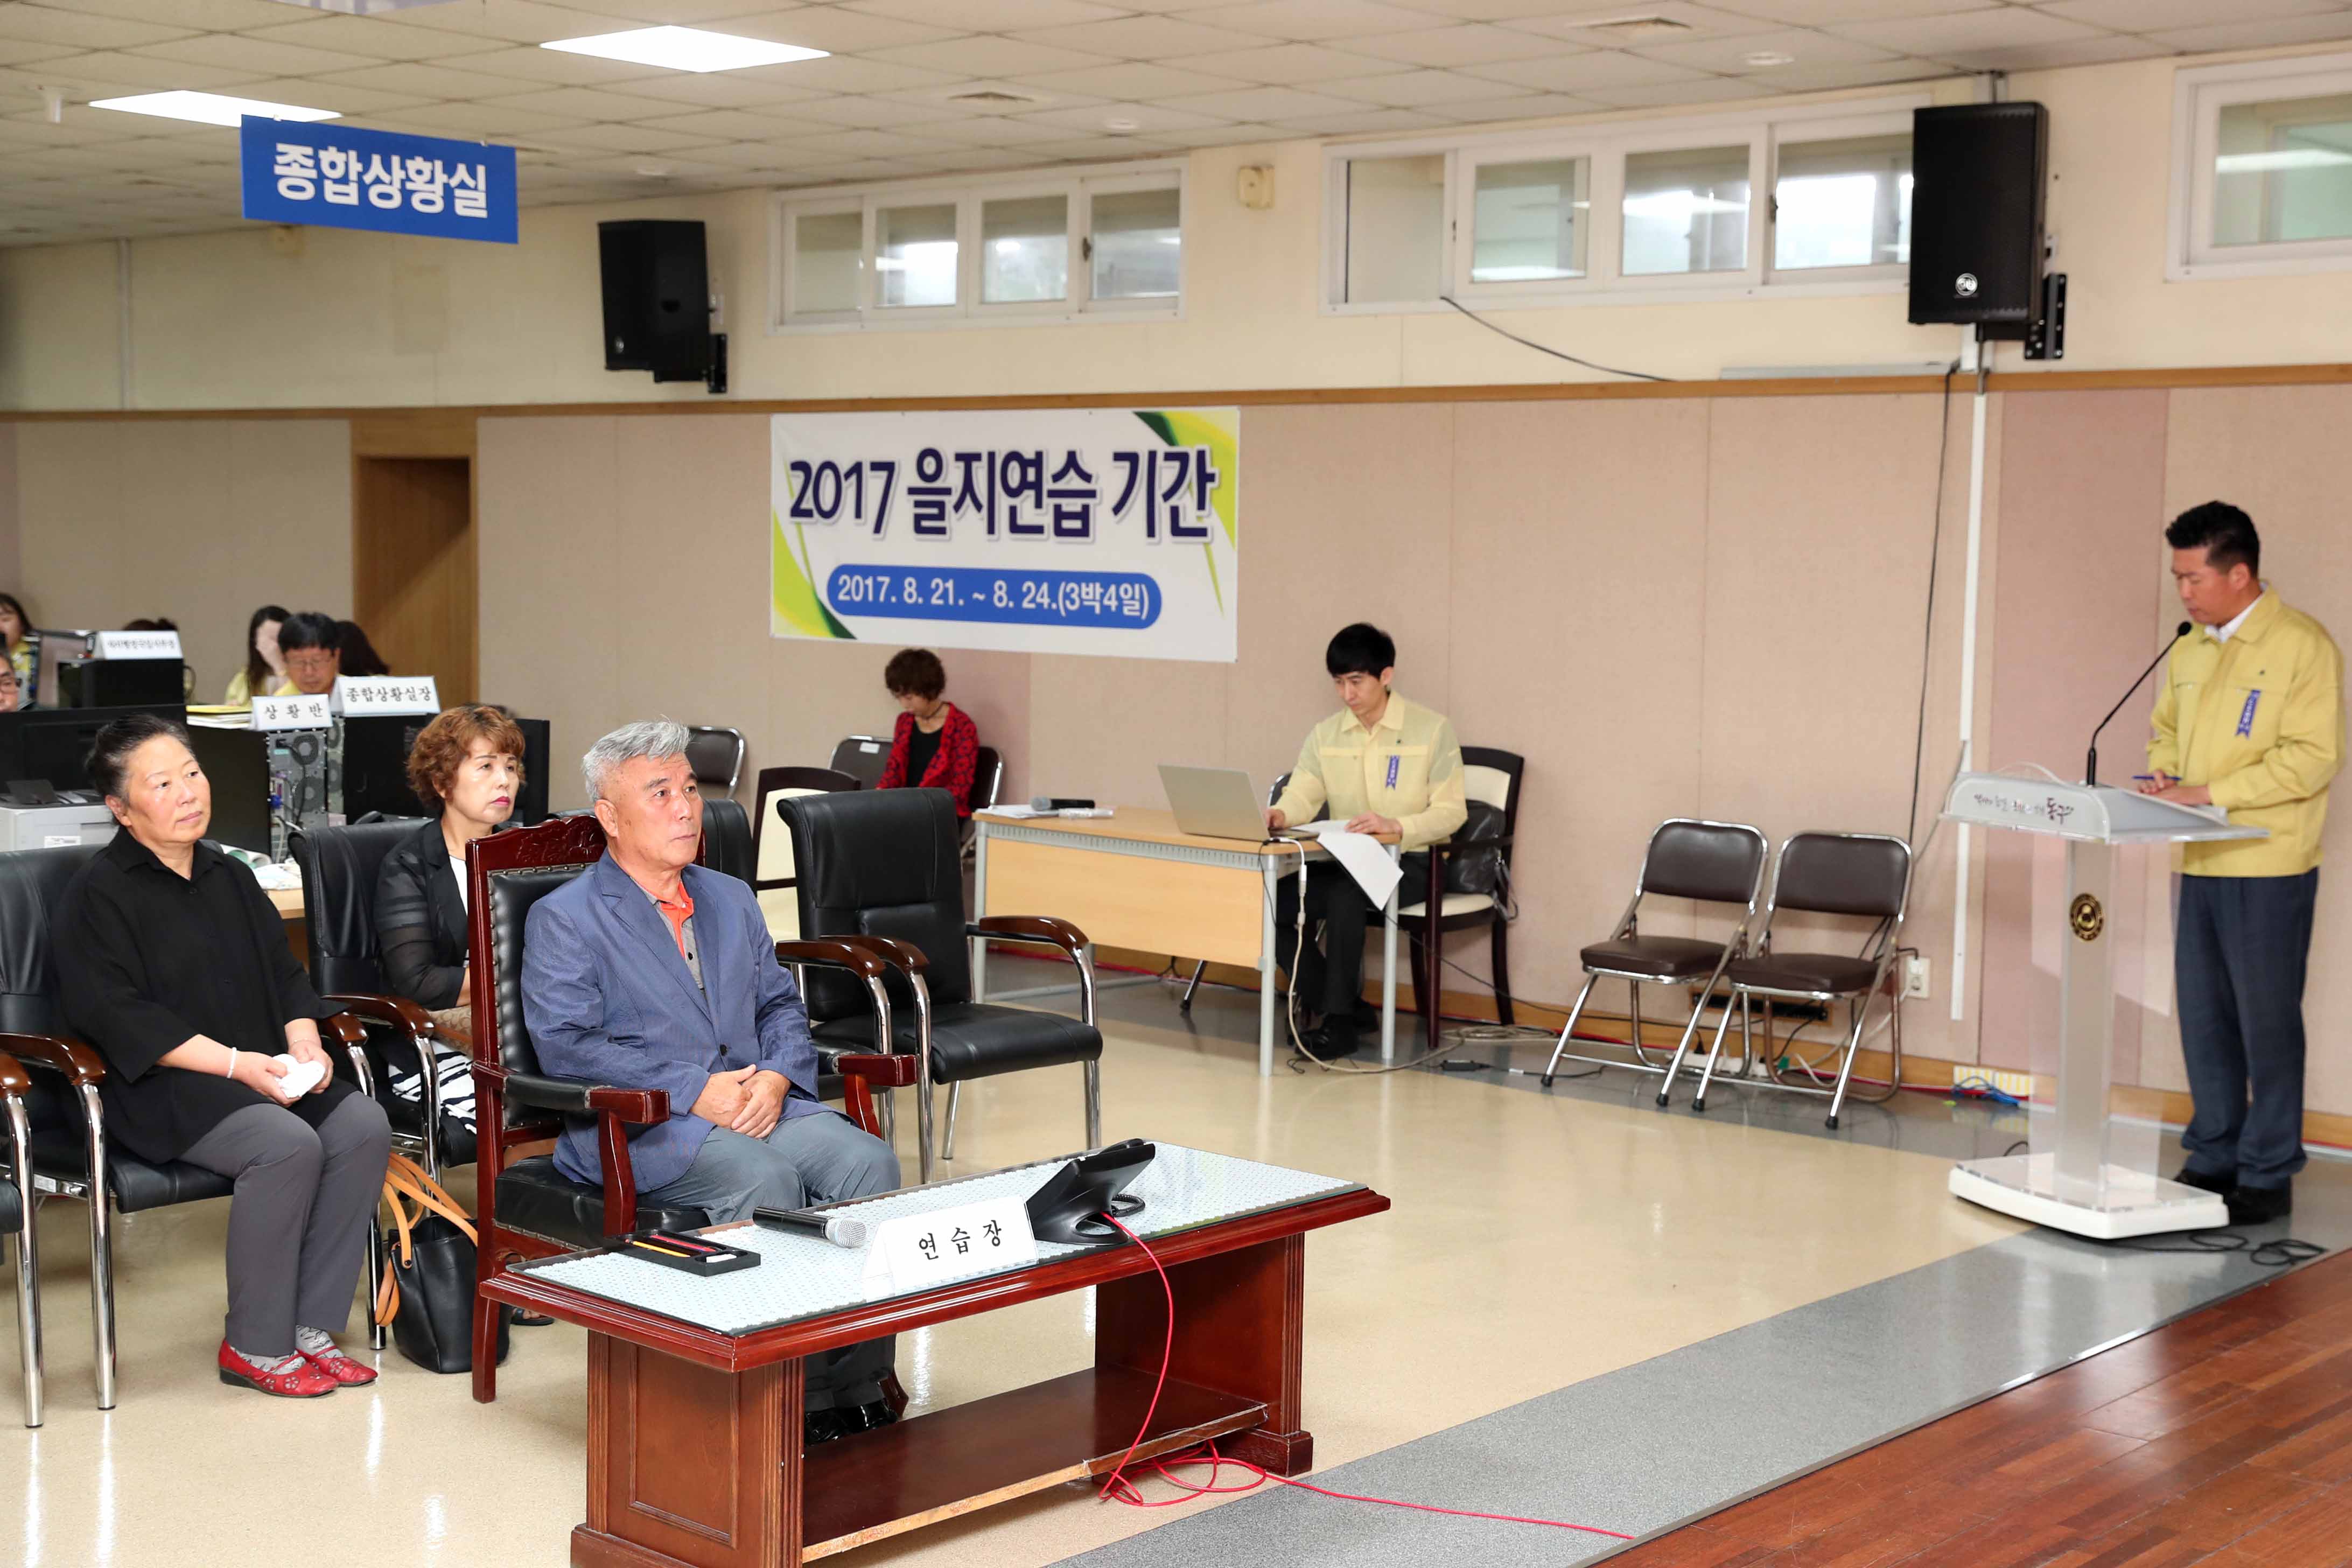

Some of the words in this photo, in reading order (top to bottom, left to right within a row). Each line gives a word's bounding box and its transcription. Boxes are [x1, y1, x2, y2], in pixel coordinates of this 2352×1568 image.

[274, 142, 488, 219] 종합상황실
[789, 460, 895, 534] 2017
[907, 447, 1097, 538] 을지연습
[1112, 449, 1216, 538] 기간
[838, 575, 897, 603] 2017.
[902, 577, 922, 605] 8.
[930, 578, 964, 606] 21.
[993, 582, 1014, 608] 8.
[346, 686, 431, 703] 종합상황실장
